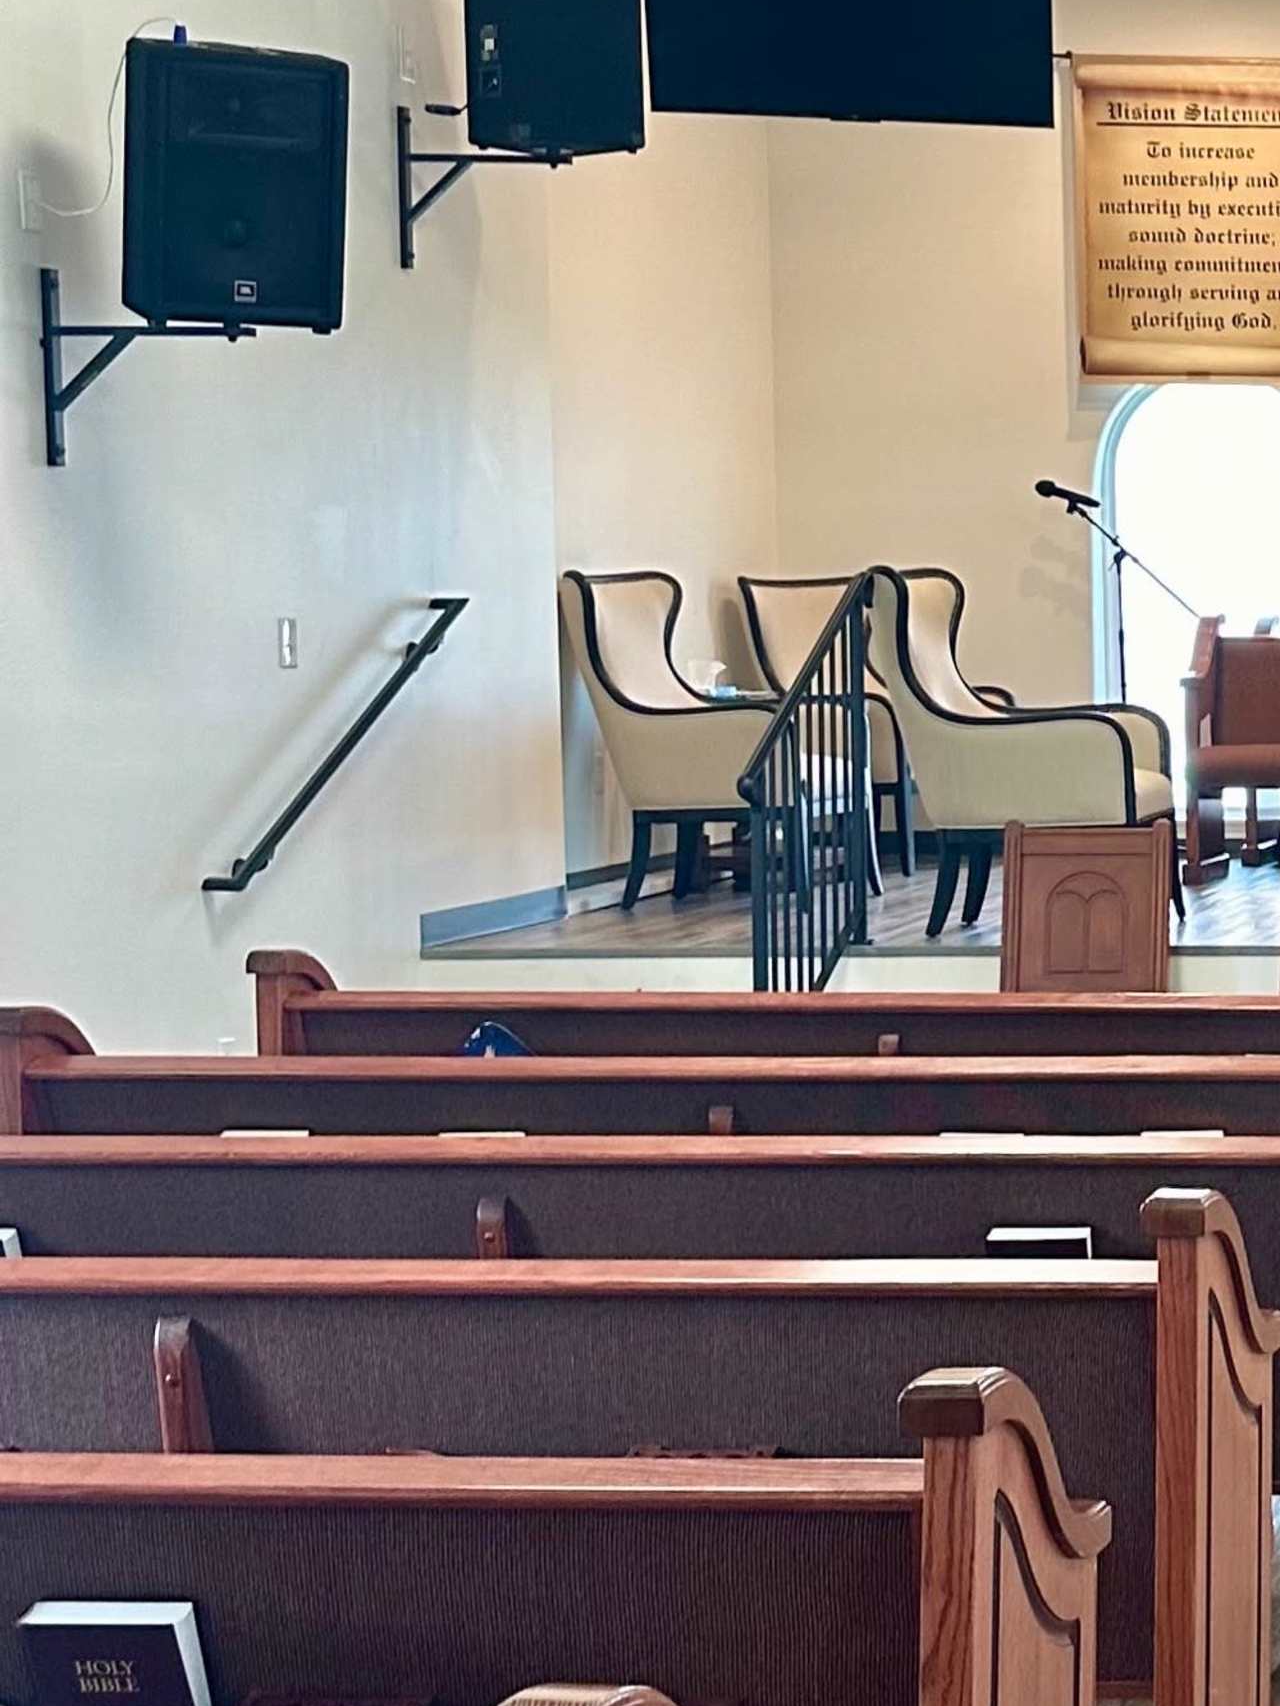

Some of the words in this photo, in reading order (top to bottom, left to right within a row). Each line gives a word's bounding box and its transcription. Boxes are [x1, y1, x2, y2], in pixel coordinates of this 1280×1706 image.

[1108, 102, 1175, 122] Vision
[1147, 142, 1172, 159] To
[1180, 142, 1255, 160] increase
[1123, 171, 1238, 190] membership
[1245, 173, 1279, 188] and
[1099, 199, 1181, 219] maturity
[1189, 200, 1211, 219] by
[1129, 228, 1186, 243] sound
[1099, 256, 1167, 275] making
[1108, 284, 1182, 303] through
[1190, 287, 1259, 304] serving
[1131, 312, 1225, 332] glorifying
[74, 1659, 135, 1676] HOLY
[79, 1676, 140, 1693] BIBLE
